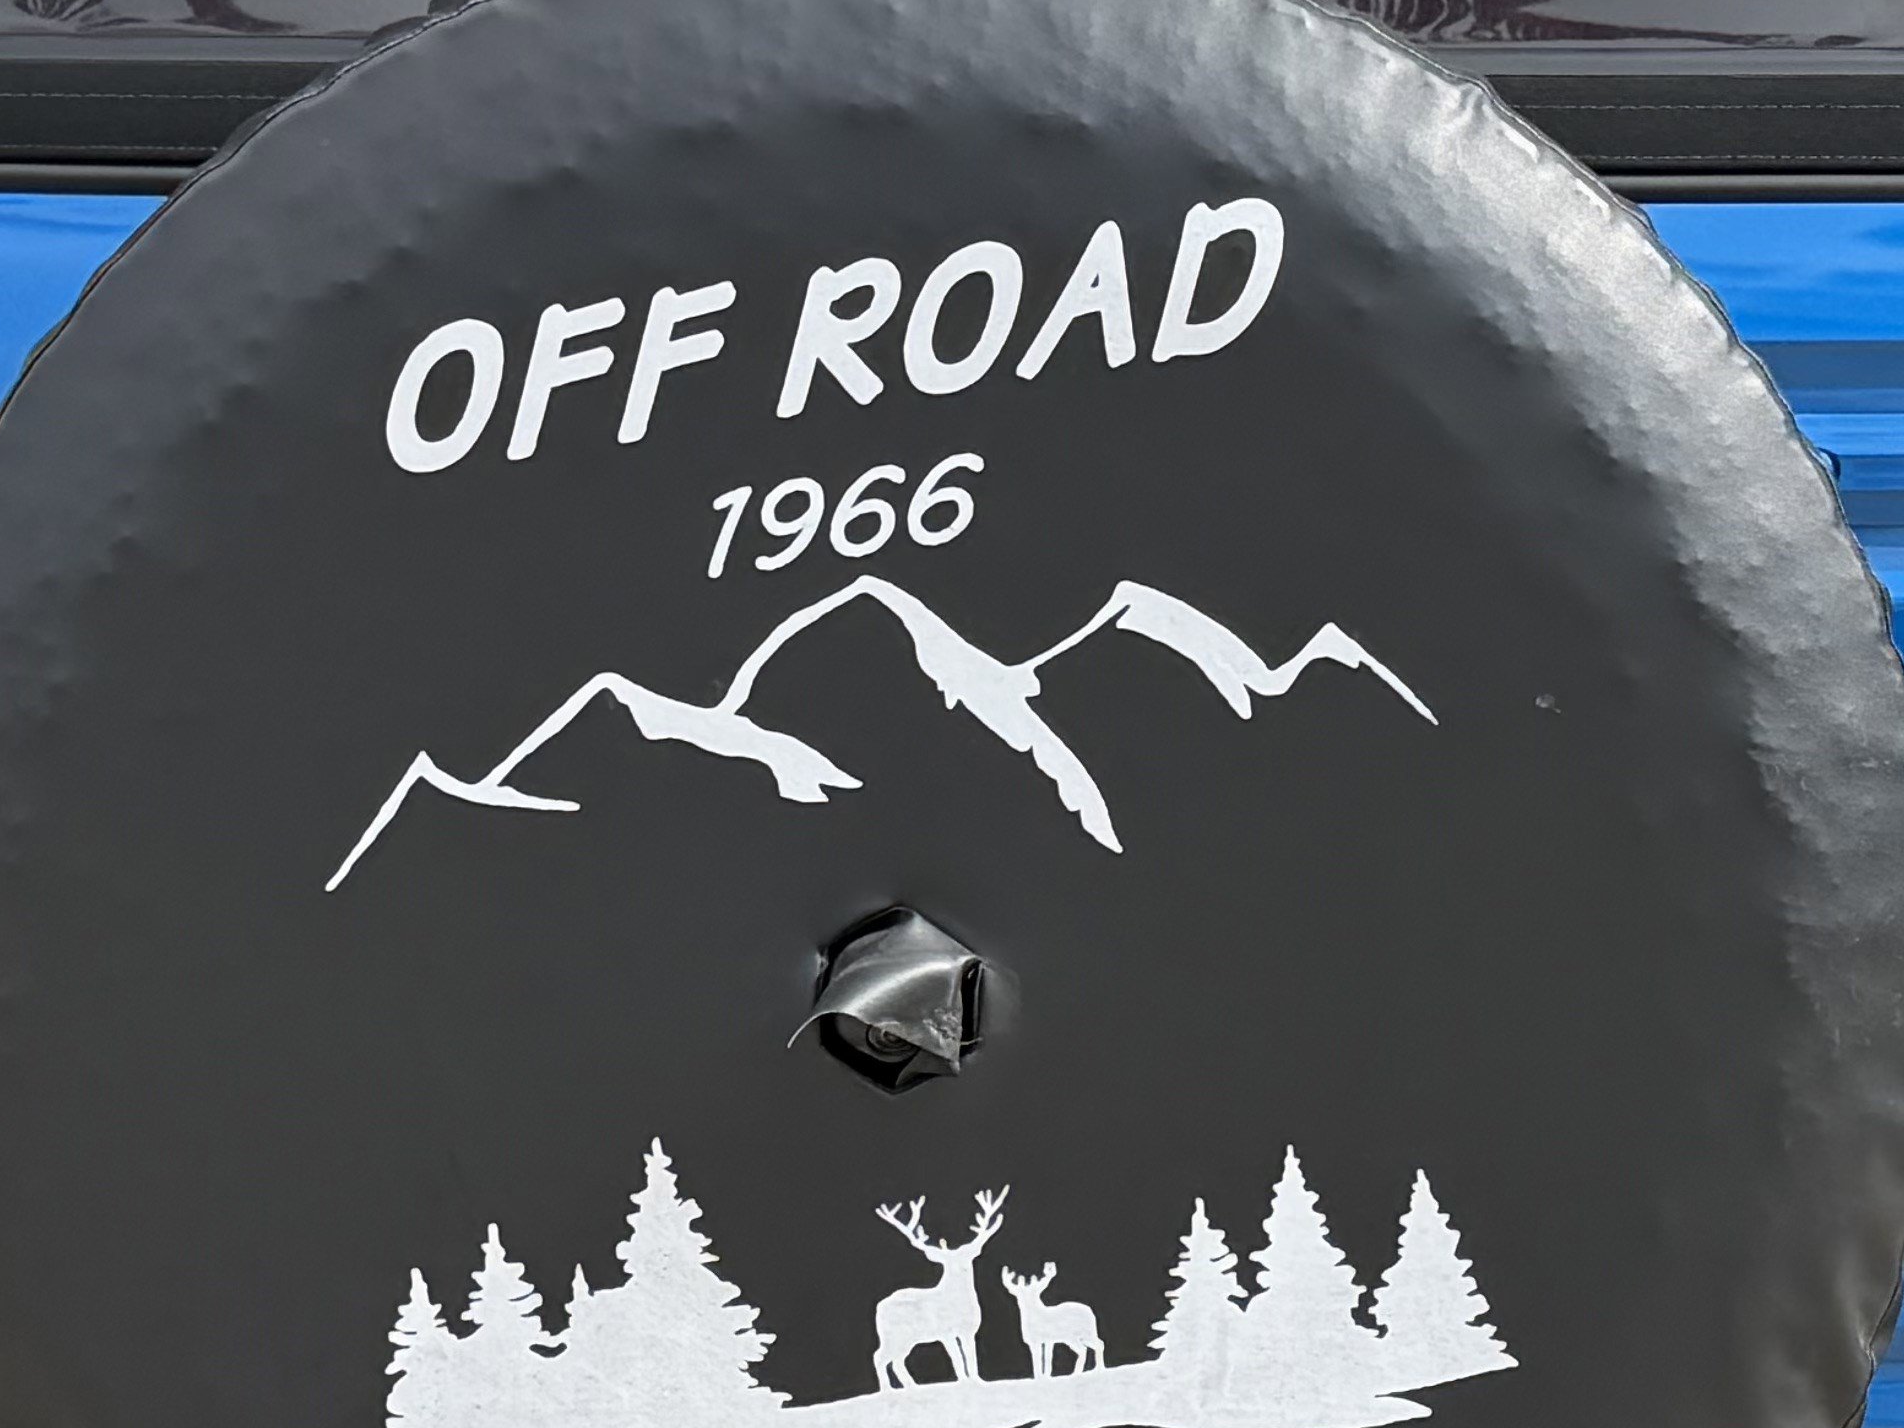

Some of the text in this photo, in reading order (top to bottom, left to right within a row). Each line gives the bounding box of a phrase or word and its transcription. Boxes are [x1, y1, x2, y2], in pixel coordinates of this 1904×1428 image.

[385, 197, 1285, 473] OFF ROAD
[707, 452, 985, 579] 1966
